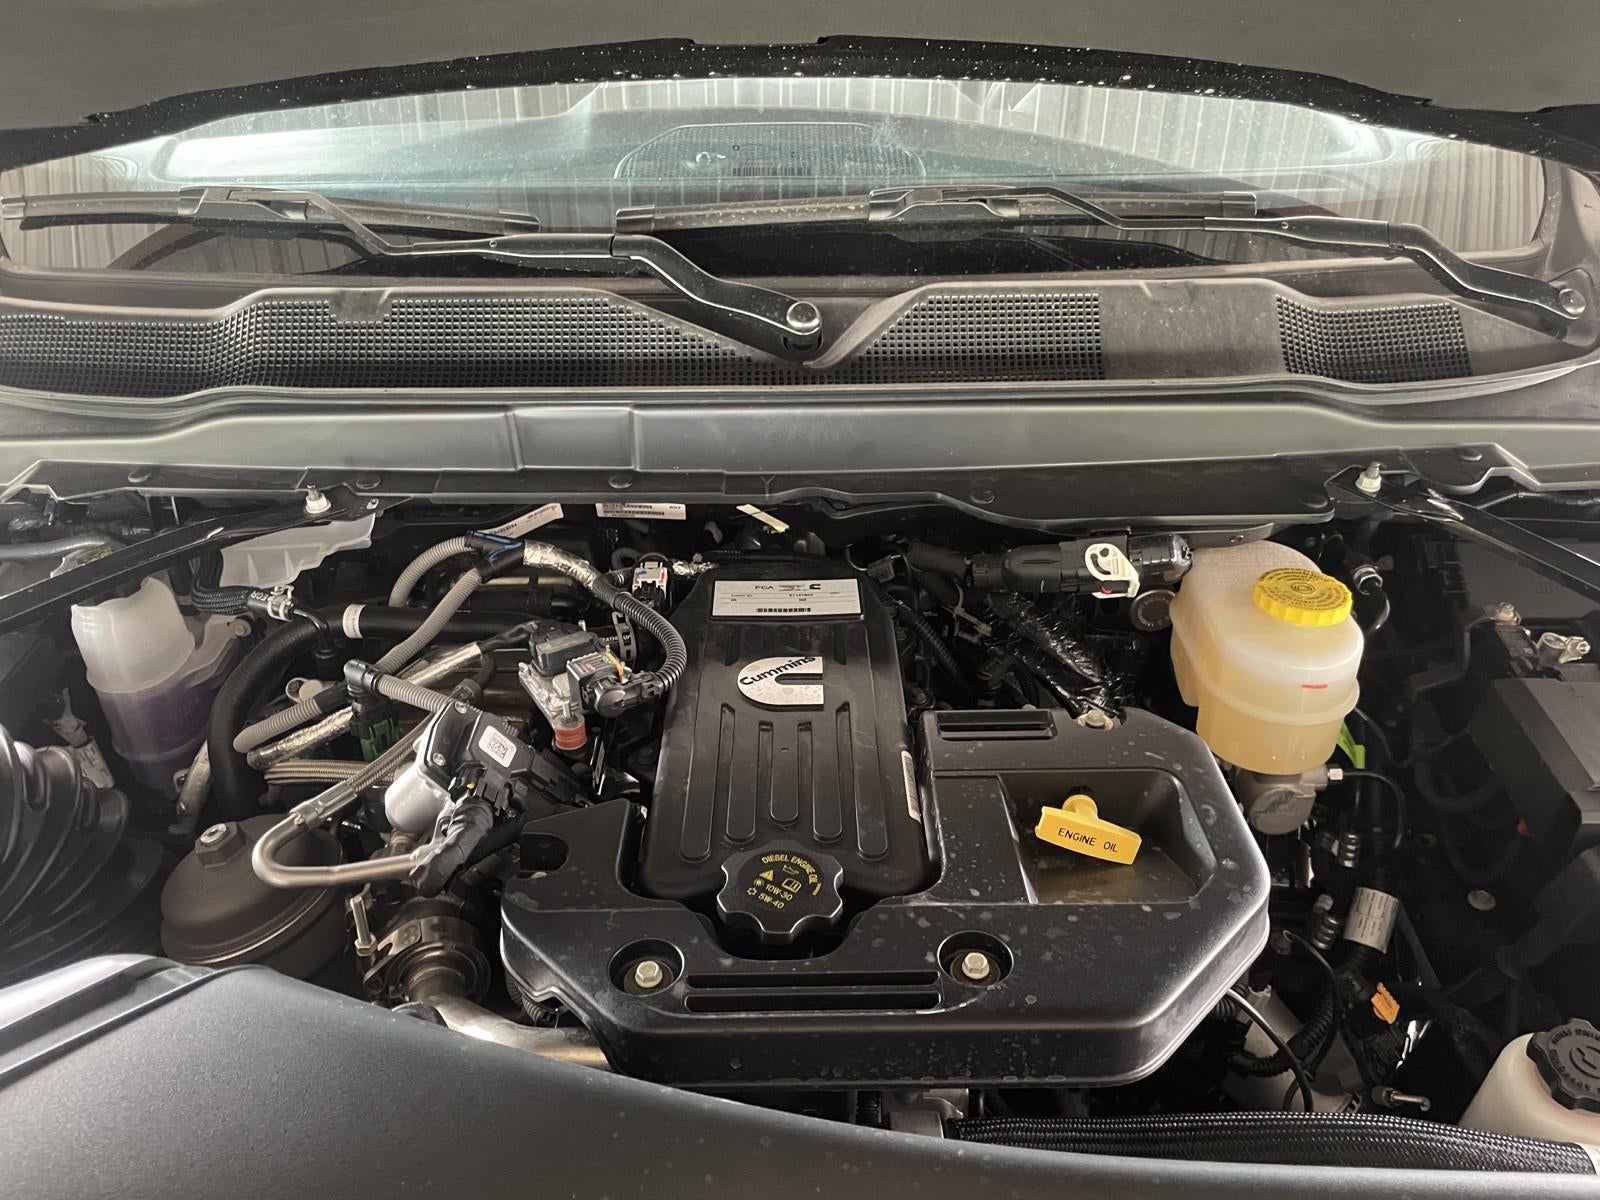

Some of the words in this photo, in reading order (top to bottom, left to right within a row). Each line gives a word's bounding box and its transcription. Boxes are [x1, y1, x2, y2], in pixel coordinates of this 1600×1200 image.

[740, 657, 816, 685] Cummins
[1058, 827, 1096, 846] ENGINE
[1103, 841, 1119, 852] OIL
[761, 854, 789, 864] DIESEL
[790, 855, 816, 875] ENGINE
[758, 892, 785, 909] 5W-40
[765, 883, 793, 901] 10W-30
